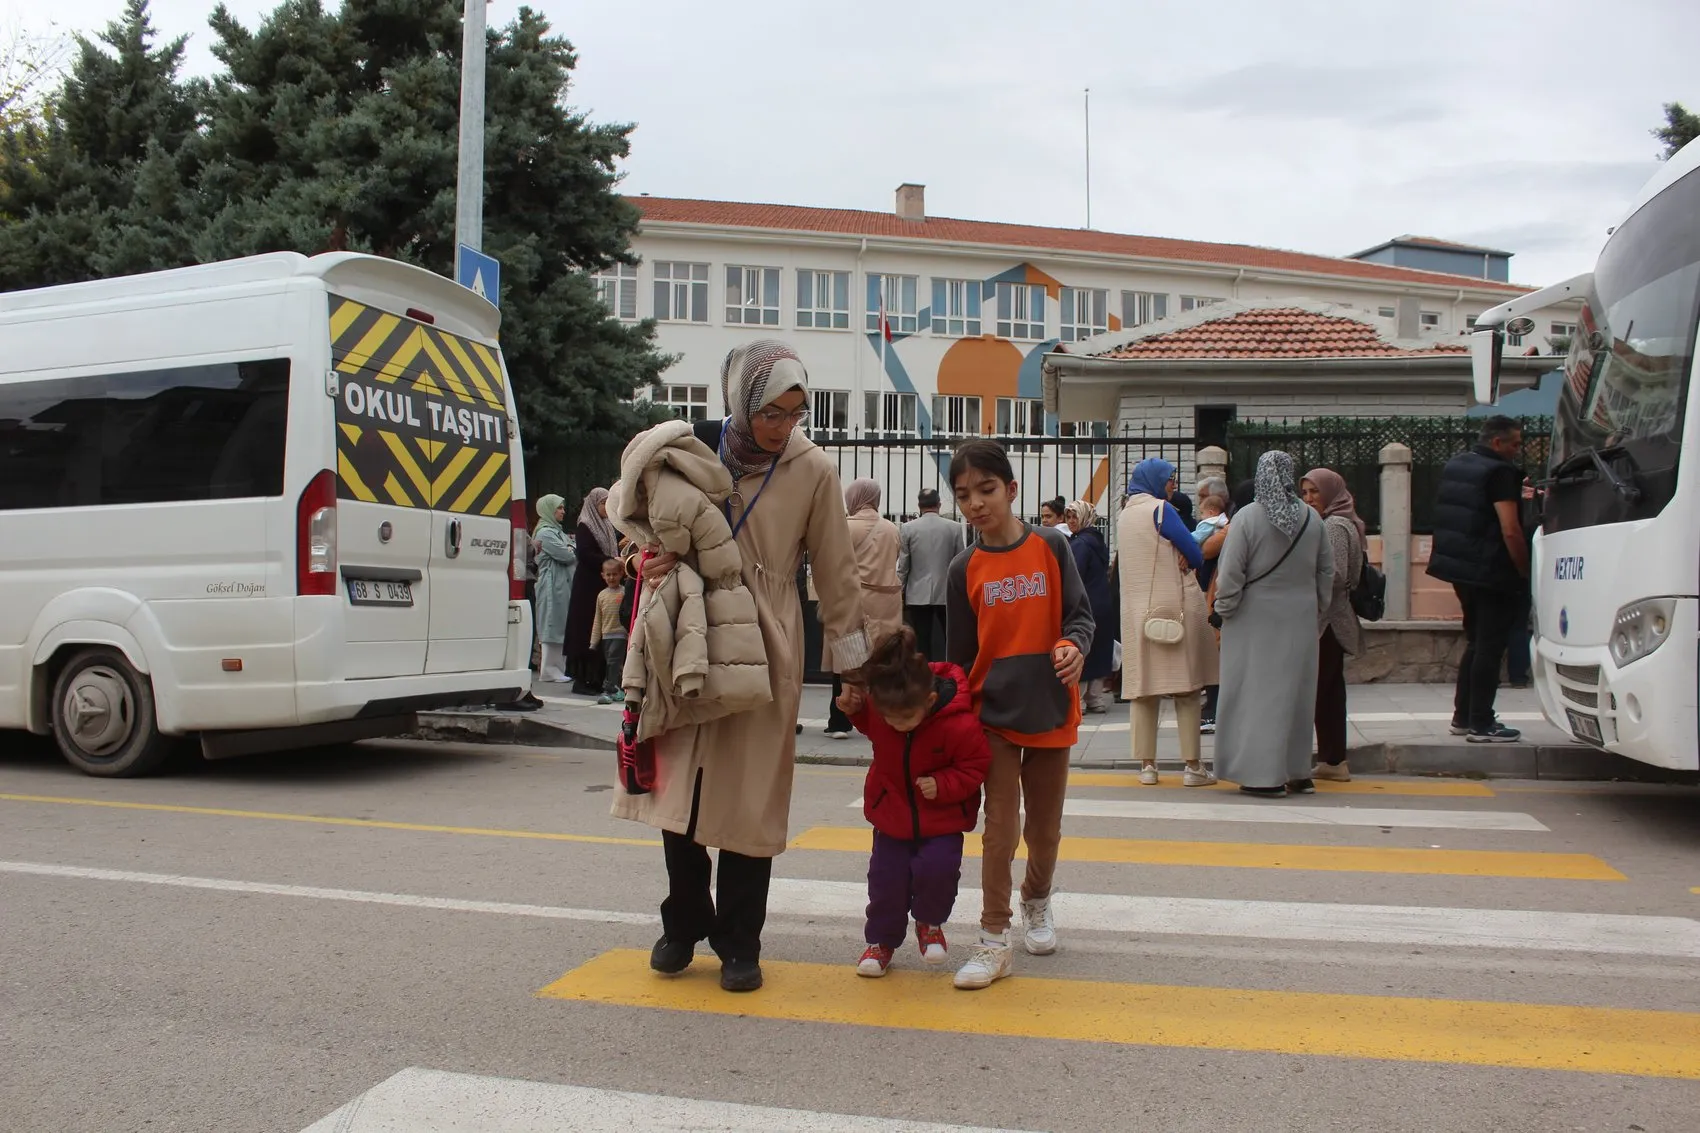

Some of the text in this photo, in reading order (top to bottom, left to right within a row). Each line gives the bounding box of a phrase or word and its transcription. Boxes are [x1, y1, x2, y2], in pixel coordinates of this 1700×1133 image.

[344, 382, 502, 444] OKUL TAŞITI
[1554, 556, 1585, 580] NEXTUR
[206, 581, 265, 598] Göksel Doğan
[355, 581, 368, 599] 68
[374, 583, 381, 599] S
[984, 572, 1046, 606] FSM
